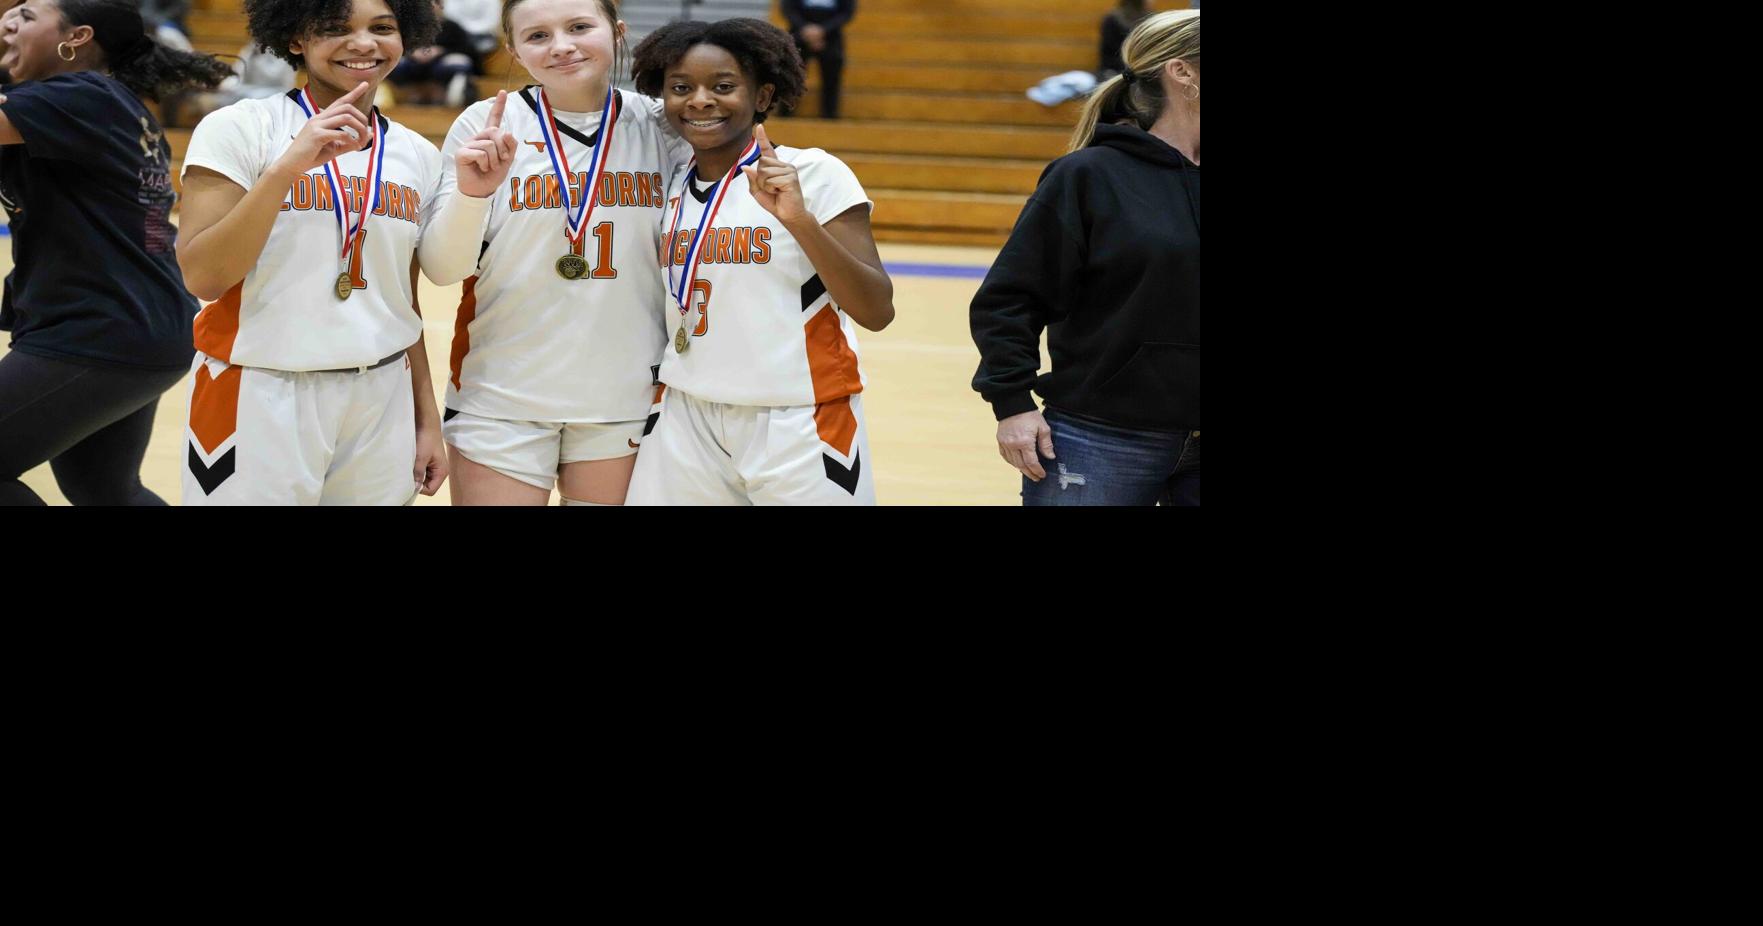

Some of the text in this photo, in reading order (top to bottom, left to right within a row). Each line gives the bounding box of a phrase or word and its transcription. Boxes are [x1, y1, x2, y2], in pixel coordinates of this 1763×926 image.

[280, 173, 421, 226] ONHORNS
[348, 229, 368, 290] 1
[660, 226, 772, 267] NGORNS
[691, 278, 712, 337] 3
